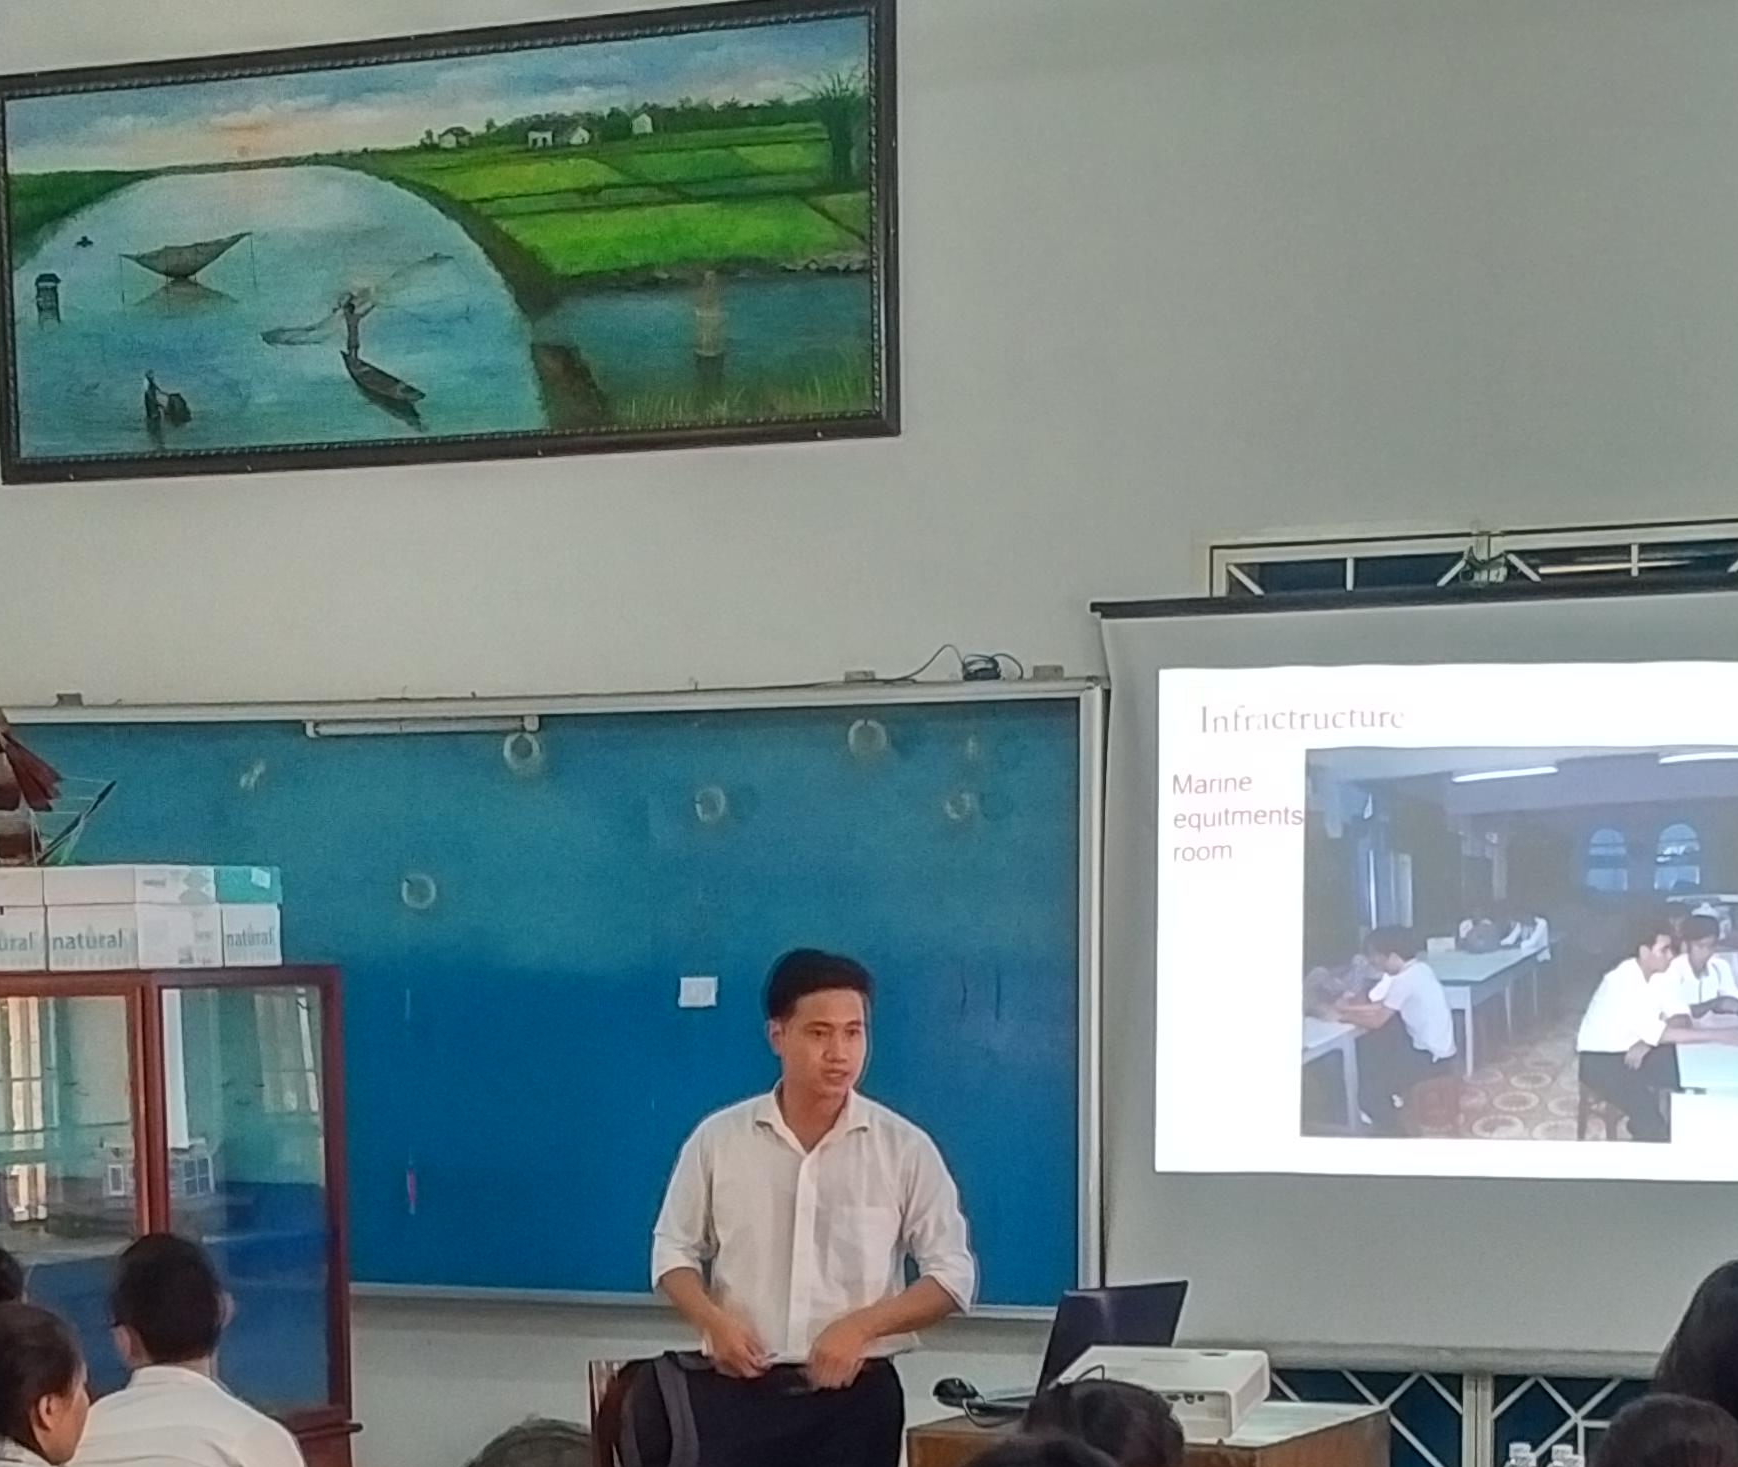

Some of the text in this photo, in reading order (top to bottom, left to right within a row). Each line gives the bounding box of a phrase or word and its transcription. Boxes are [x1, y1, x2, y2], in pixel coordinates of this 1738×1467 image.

[1172, 774, 1253, 795] Marine
[1173, 807, 1304, 833] equitments
[1173, 843, 1233, 863] room
[52, 927, 124, 951] natural
[226, 926, 274, 947] natural
